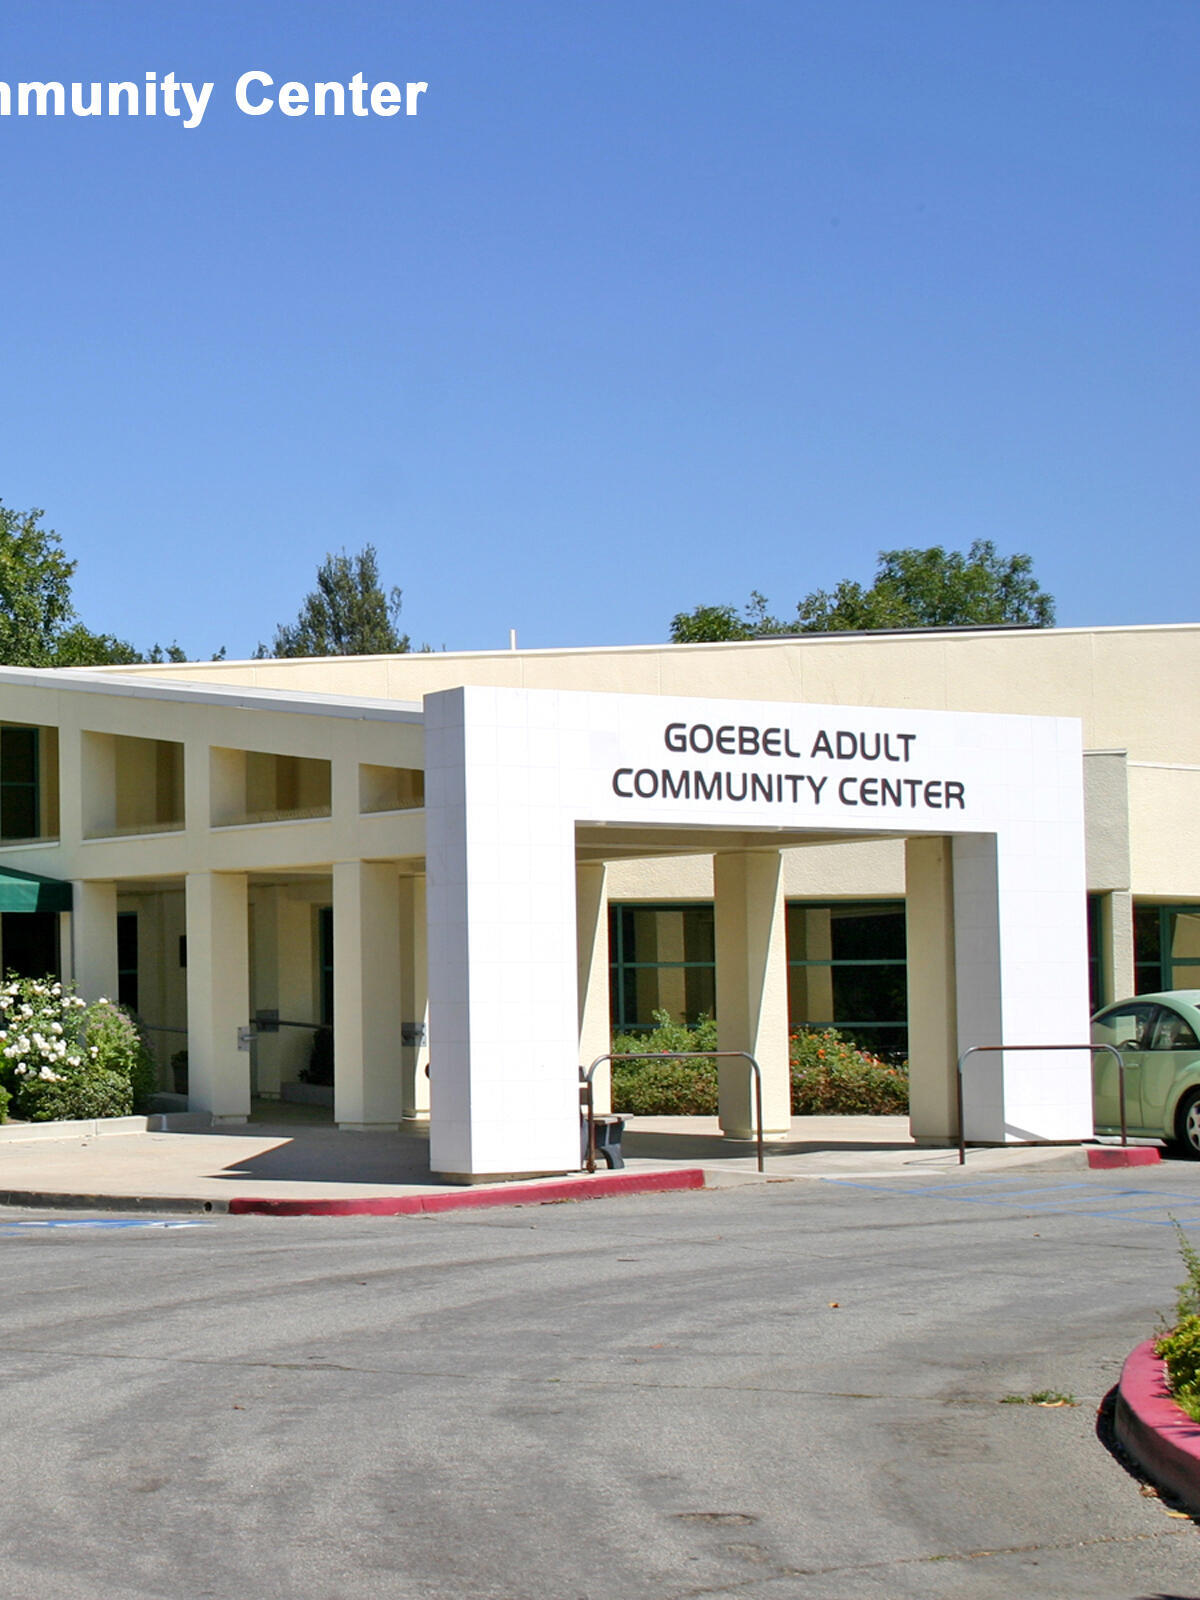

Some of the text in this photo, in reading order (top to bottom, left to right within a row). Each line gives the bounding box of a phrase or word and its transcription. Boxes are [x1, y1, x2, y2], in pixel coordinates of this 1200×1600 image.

[664, 722, 917, 763] GOEBEL ADULT
[612, 767, 965, 810] COMMUNITY CENTER
